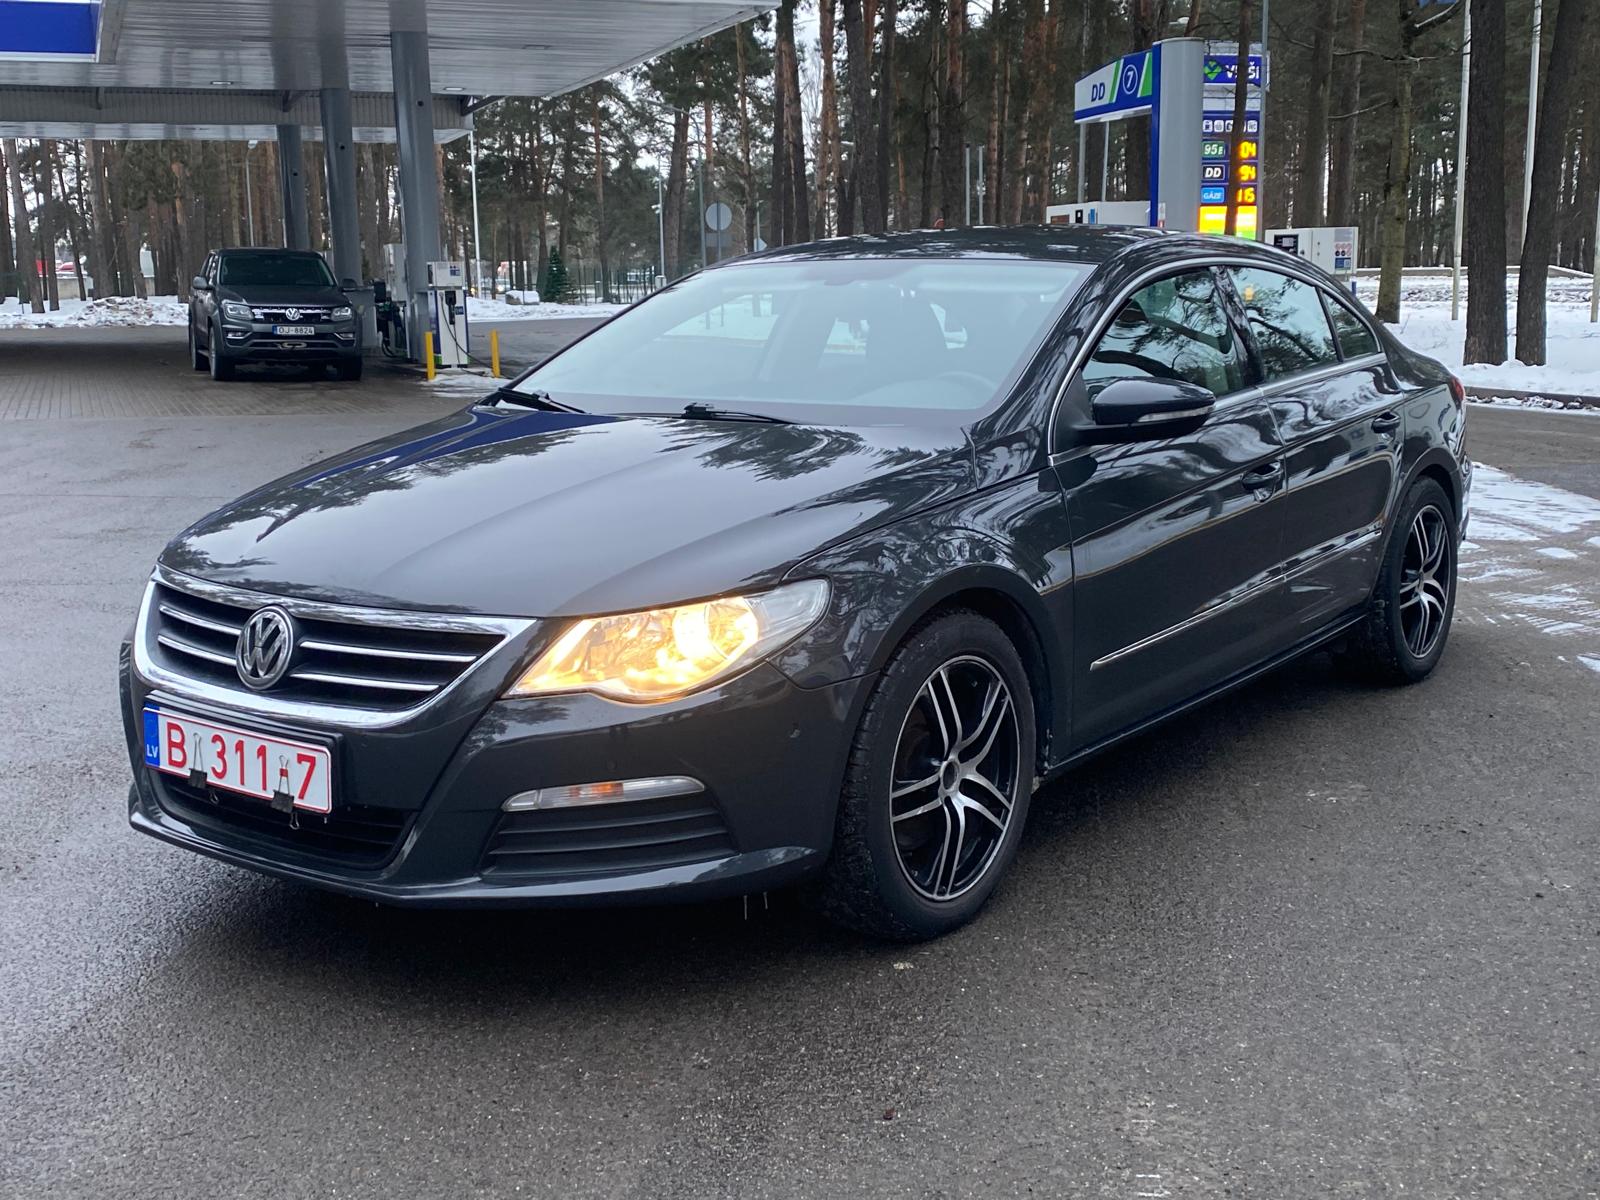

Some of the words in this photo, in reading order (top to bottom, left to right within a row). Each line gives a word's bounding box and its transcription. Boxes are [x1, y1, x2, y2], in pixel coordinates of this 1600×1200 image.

[1126, 70, 1134, 89] 7
[1091, 82, 1105, 102] DD
[1204, 167, 1222, 178] DD
[146, 744, 158, 758] LV
[166, 721, 187, 768] B
